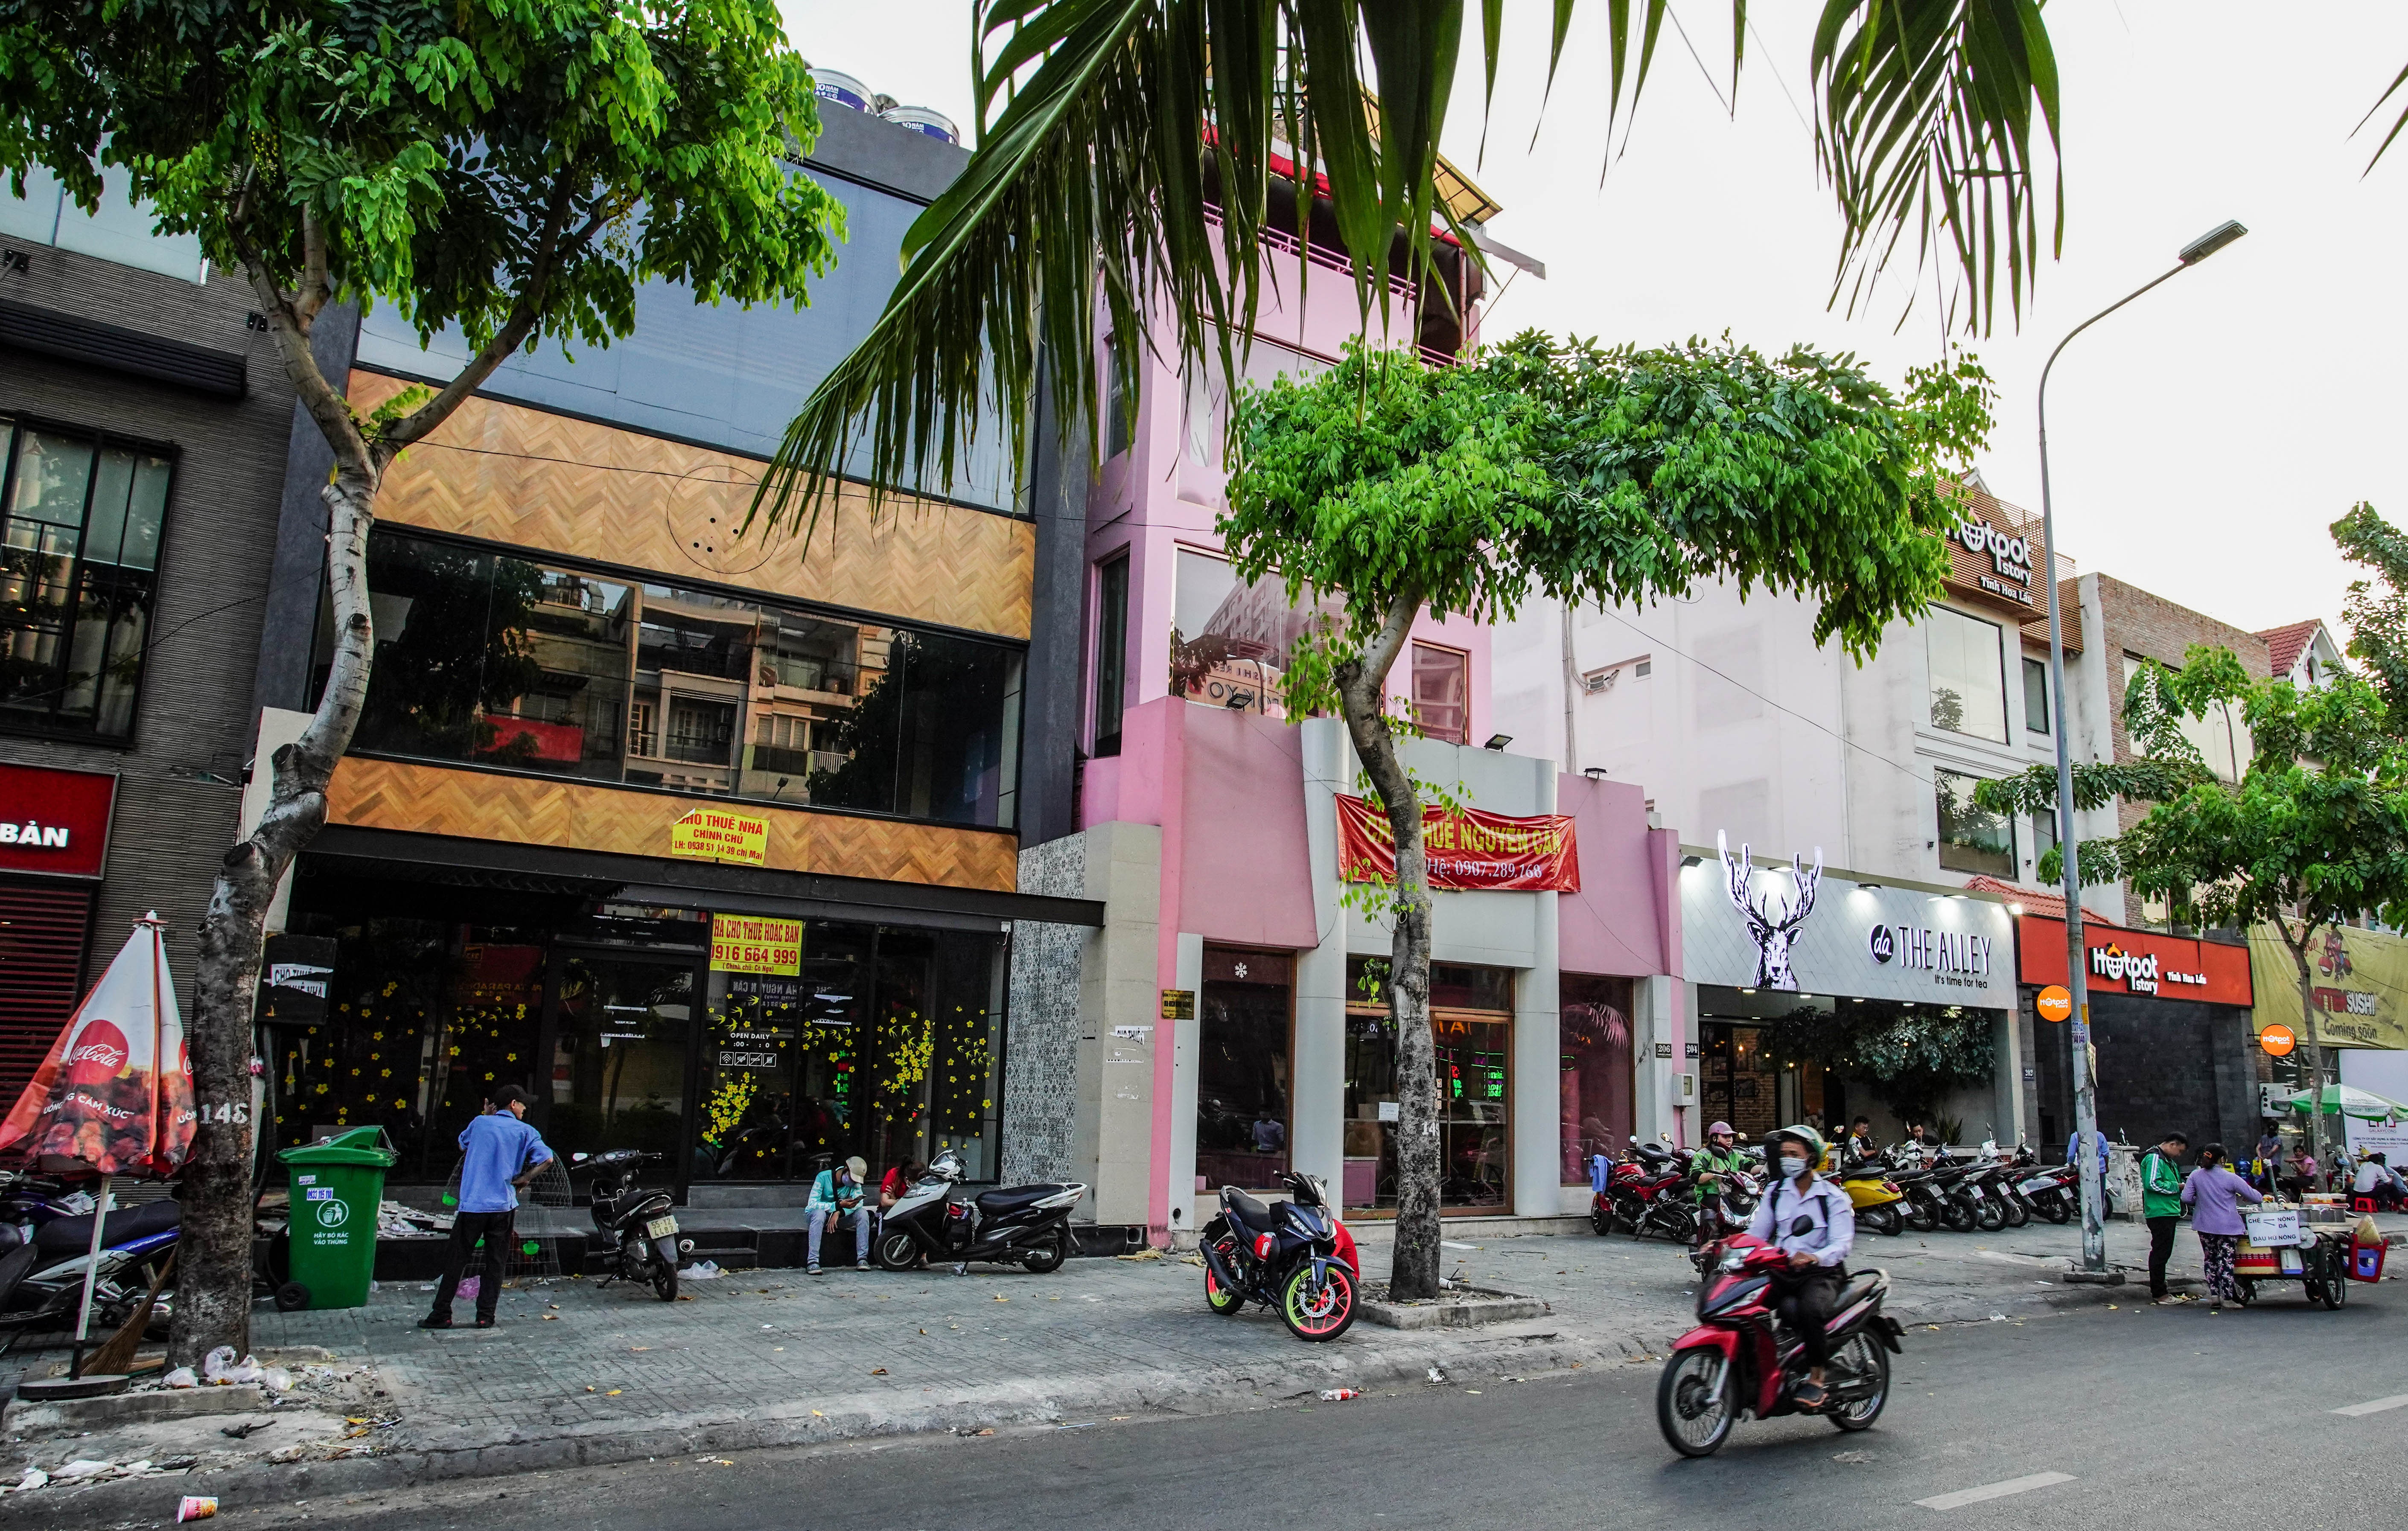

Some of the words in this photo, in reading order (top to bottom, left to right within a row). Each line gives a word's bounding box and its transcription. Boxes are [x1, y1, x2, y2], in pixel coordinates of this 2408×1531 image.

[2002, 561, 2032, 587] story
[0, 820, 69, 847] BẢN
[706, 815, 735, 830] THUÊ
[738, 821, 762, 835] NHÀ
[694, 829, 722, 840] CHÍNH
[724, 833, 743, 844] CHỦ
[1460, 823, 1528, 854] NGUYÊN
[688, 841, 704, 850] 0938
[706, 843, 714, 851] 51
[749, 850, 763, 860] Mai
[1455, 860, 1542, 879] 0907.289.168
[726, 920, 741, 939] CHO
[743, 919, 763, 941] THUÊ
[764, 920, 783, 945] HOẶC
[744, 947, 768, 962] 664
[773, 949, 797, 964] 999
[1897, 926, 1933, 969] THE
[1937, 932, 1991, 976] ALLEY
[1935, 975, 1944, 984] It's
[1947, 975, 1962, 987] time
[1964, 977, 1974, 987] for
[1976, 979, 1988, 988] tea
[2136, 978, 2158, 995] story
[2167, 972, 2181, 982] Tinh
[2183, 974, 2195, 984] Hoa
[2347, 991, 2376, 1016] SUSHI
[2324, 1019, 2356, 1041] Coming
[2358, 1025, 2377, 1039] soon
[68, 1043, 127, 1068] Coca-Cola
[1658, 1045, 1670, 1053] 206
[655, 1225, 674, 1237] 4482
